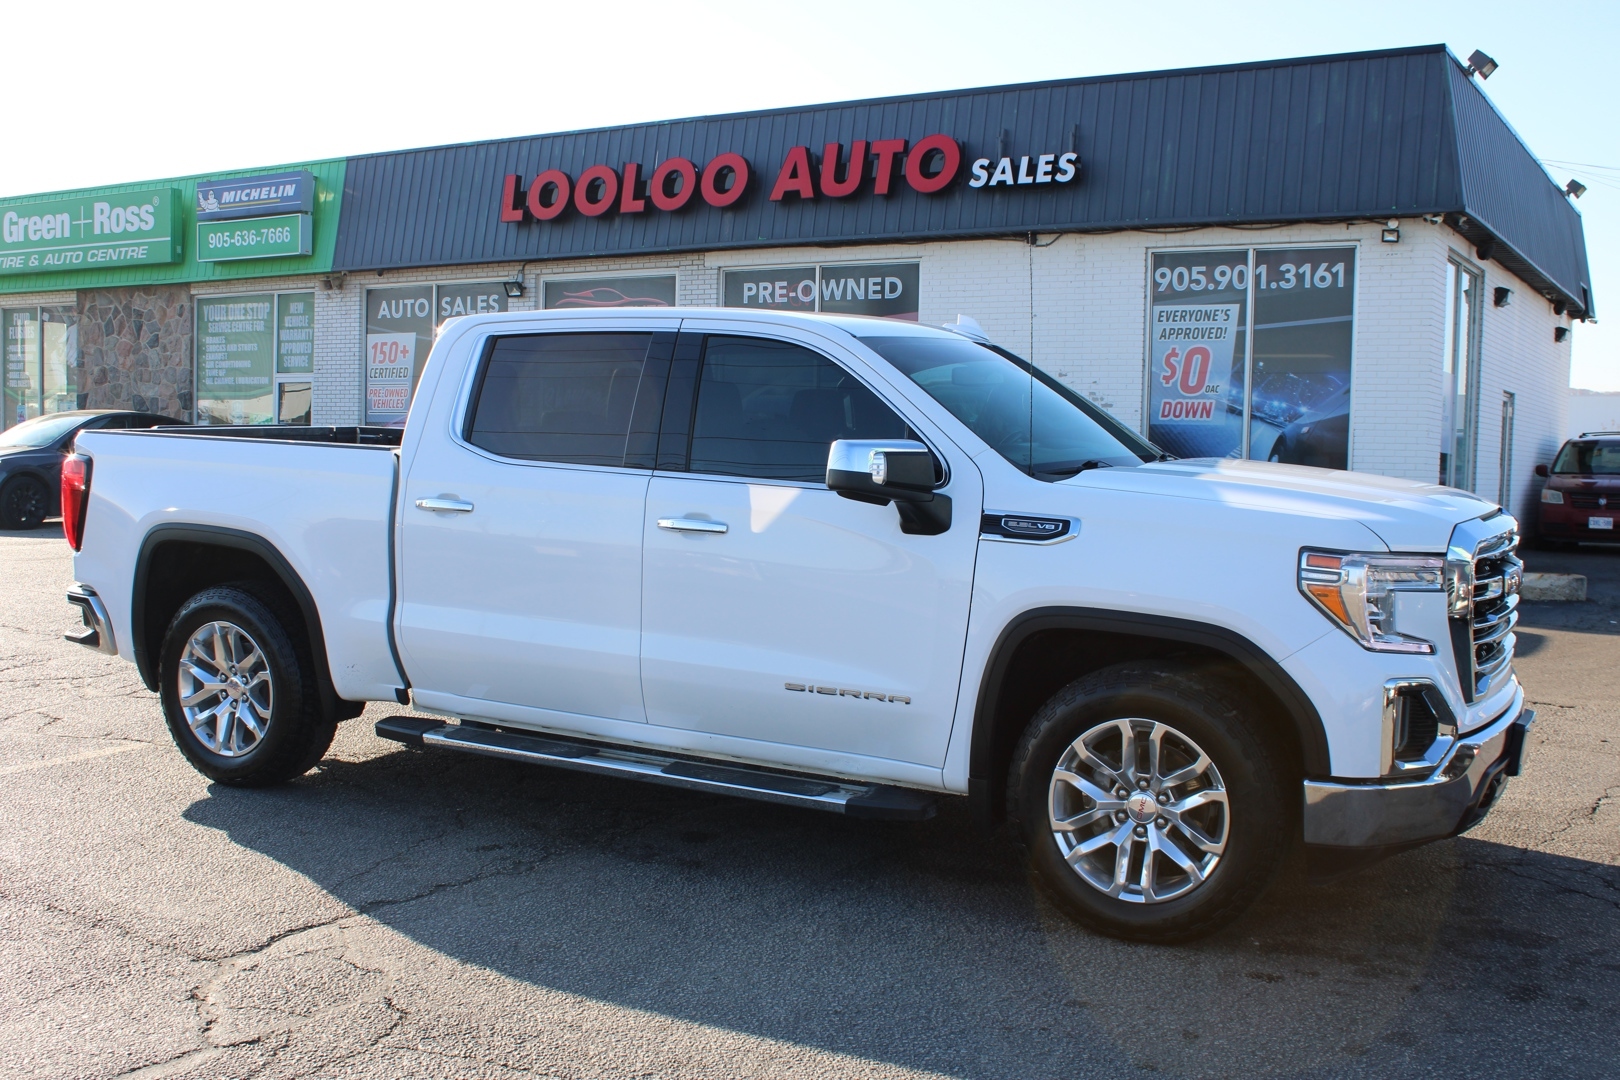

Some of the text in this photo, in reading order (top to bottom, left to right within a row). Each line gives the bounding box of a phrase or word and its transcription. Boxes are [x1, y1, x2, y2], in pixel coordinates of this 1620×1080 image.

[501, 134, 1078, 223] LOOLOO AUTO SALES
[221, 184, 296, 203] MICHELIN
[3, 211, 70, 243] Green
[93, 202, 155, 235] Ross
[208, 226, 290, 248] 905-636-7666
[28, 254, 39, 267] &
[43, 251, 83, 266] AUTO
[87, 246, 149, 262] CENTRE
[1154, 262, 1345, 292] 905.901.3161
[743, 276, 903, 304] PRE-OWNED
[203, 302, 270, 321] YOUR ONE STOP
[289, 302, 304, 314] NEW
[377, 294, 500, 319] AUTO SALES
[1157, 308, 1231, 323] EVERYONE'S
[1158, 326, 1228, 341] APPROVED!
[371, 341, 409, 365] 150+
[369, 367, 409, 379] CERTIFIED
[1161, 346, 1220, 394] $0 OAC
[369, 388, 409, 398] PRE-OWNED
[372, 398, 405, 409] VEHICLES
[1160, 400, 1213, 419] DOWN
[784, 682, 911, 705] SIERRA
[1136, 797, 1147, 820] GMC
